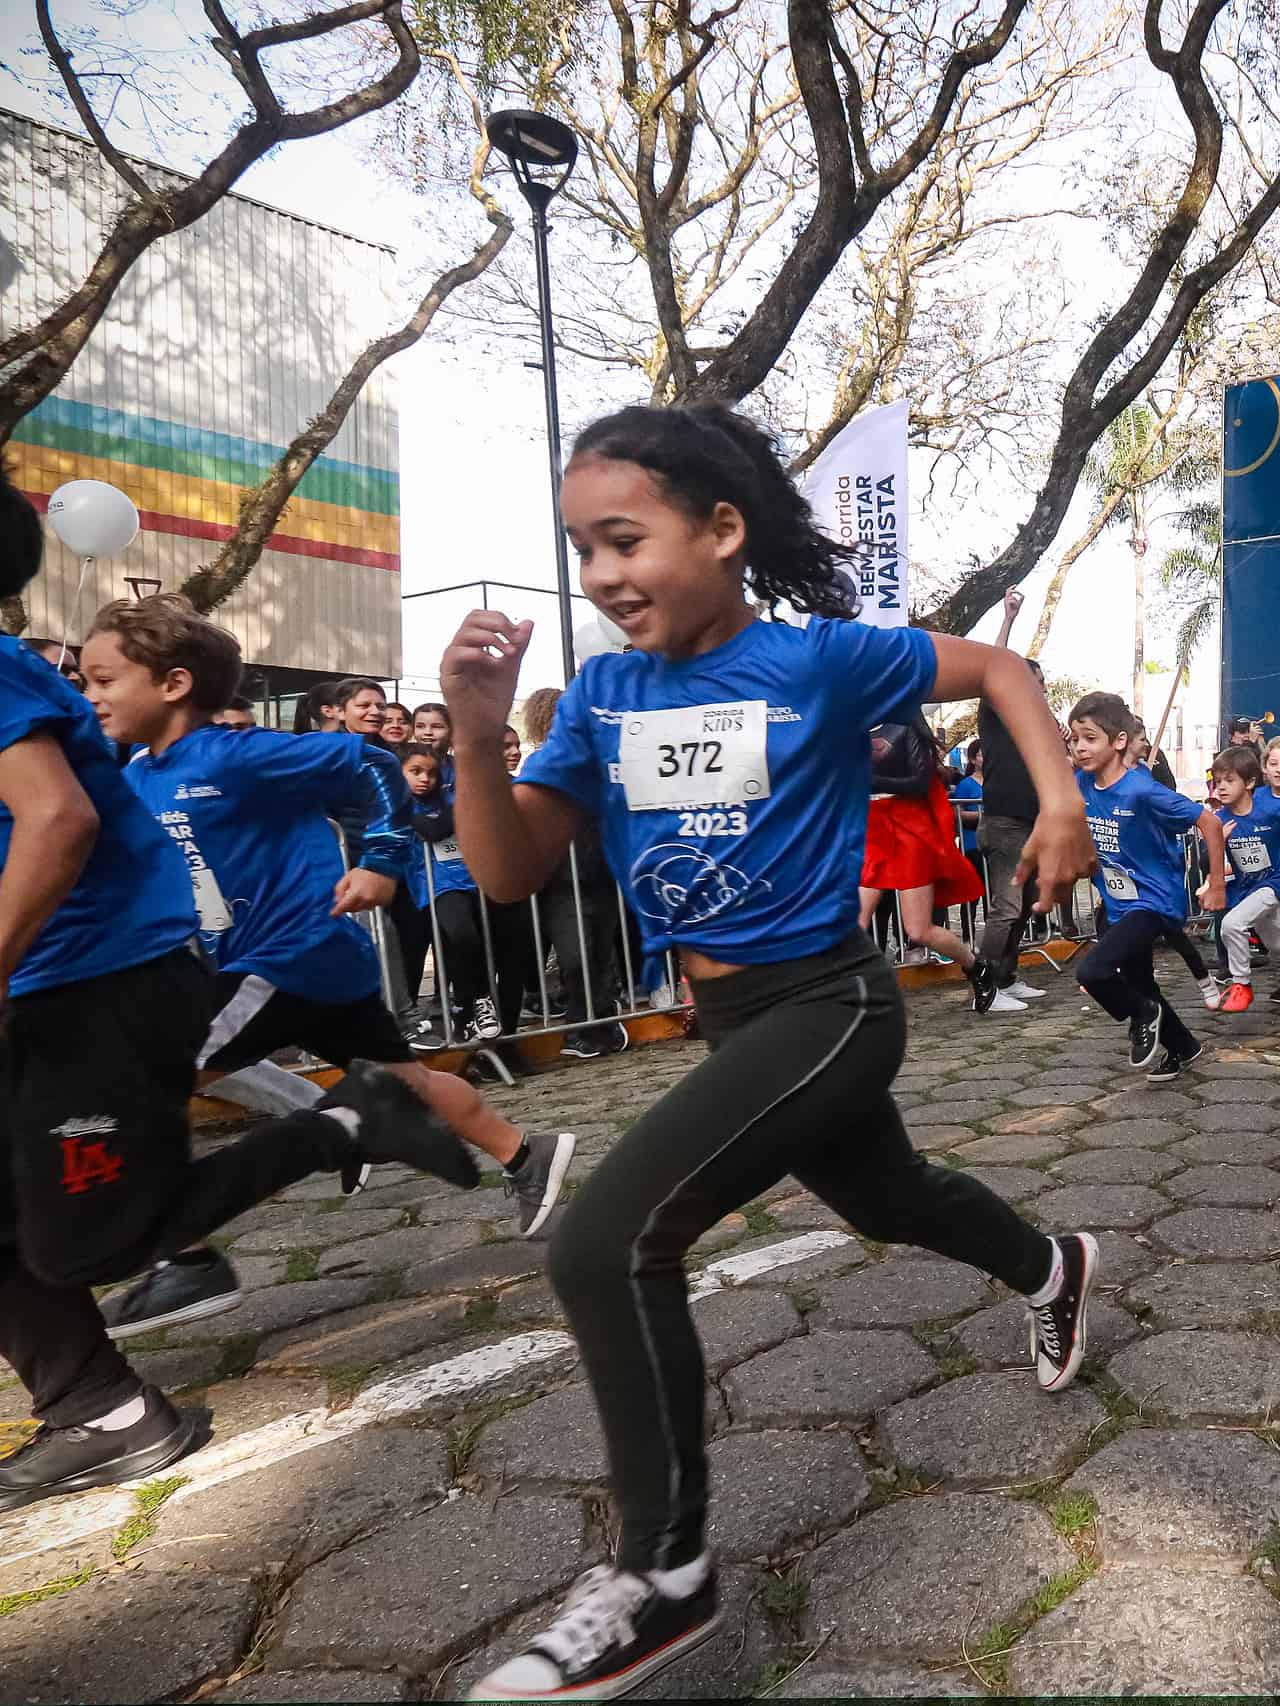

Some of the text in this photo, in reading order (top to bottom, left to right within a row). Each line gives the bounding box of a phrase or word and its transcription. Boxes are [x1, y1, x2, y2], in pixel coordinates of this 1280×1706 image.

[876, 473, 900, 609] MARISTA
[703, 716, 744, 733] KIDS
[657, 740, 723, 778] 372
[677, 811, 748, 837] 2023
[1093, 833, 1119, 845] ARISTA
[1107, 879, 1125, 890] 03
